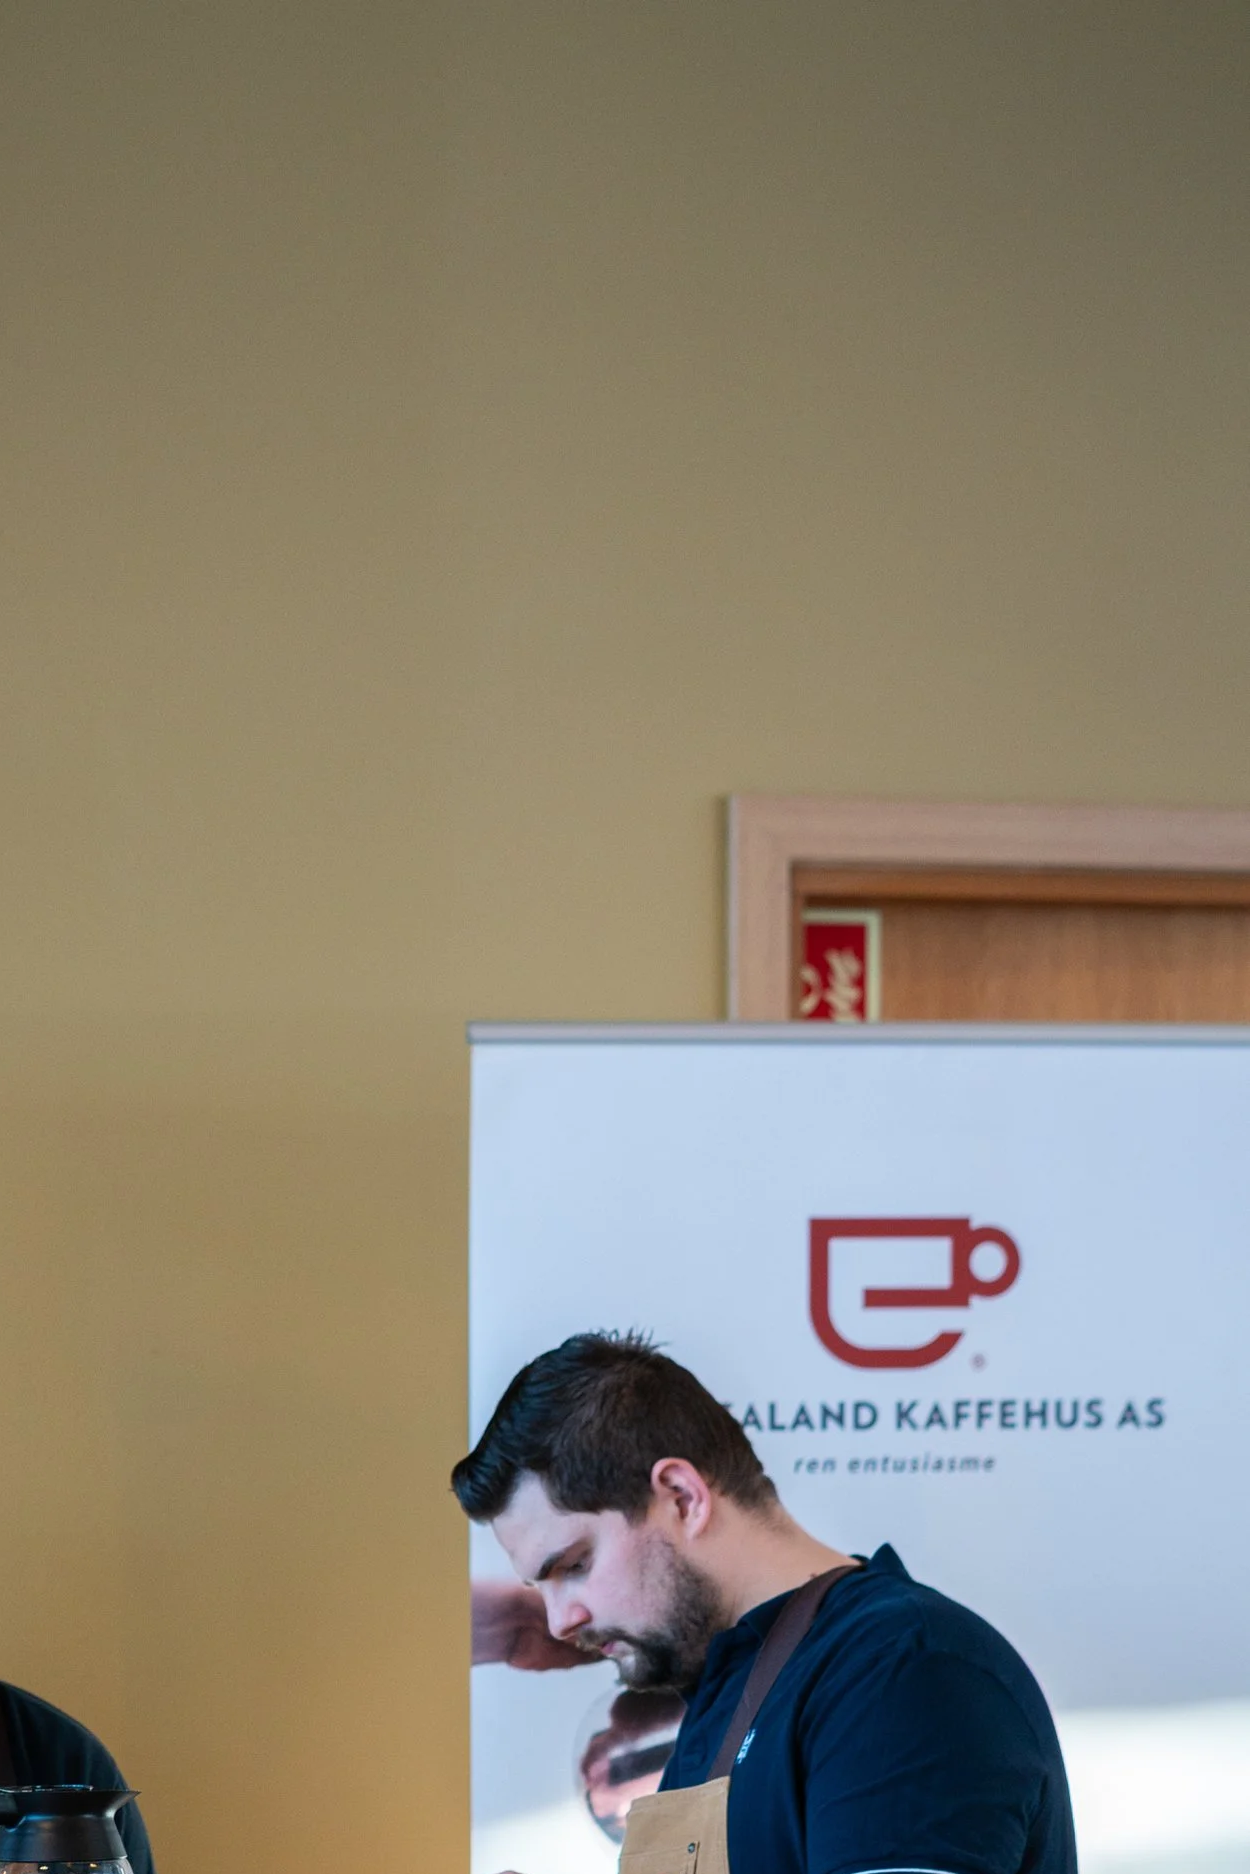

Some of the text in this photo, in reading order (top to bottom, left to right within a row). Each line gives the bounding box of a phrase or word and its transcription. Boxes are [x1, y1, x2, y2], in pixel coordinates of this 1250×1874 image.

[727, 1397, 1165, 1431] ALAND KAFFEHUS AS
[794, 1451, 997, 1474] ren entusiasme
